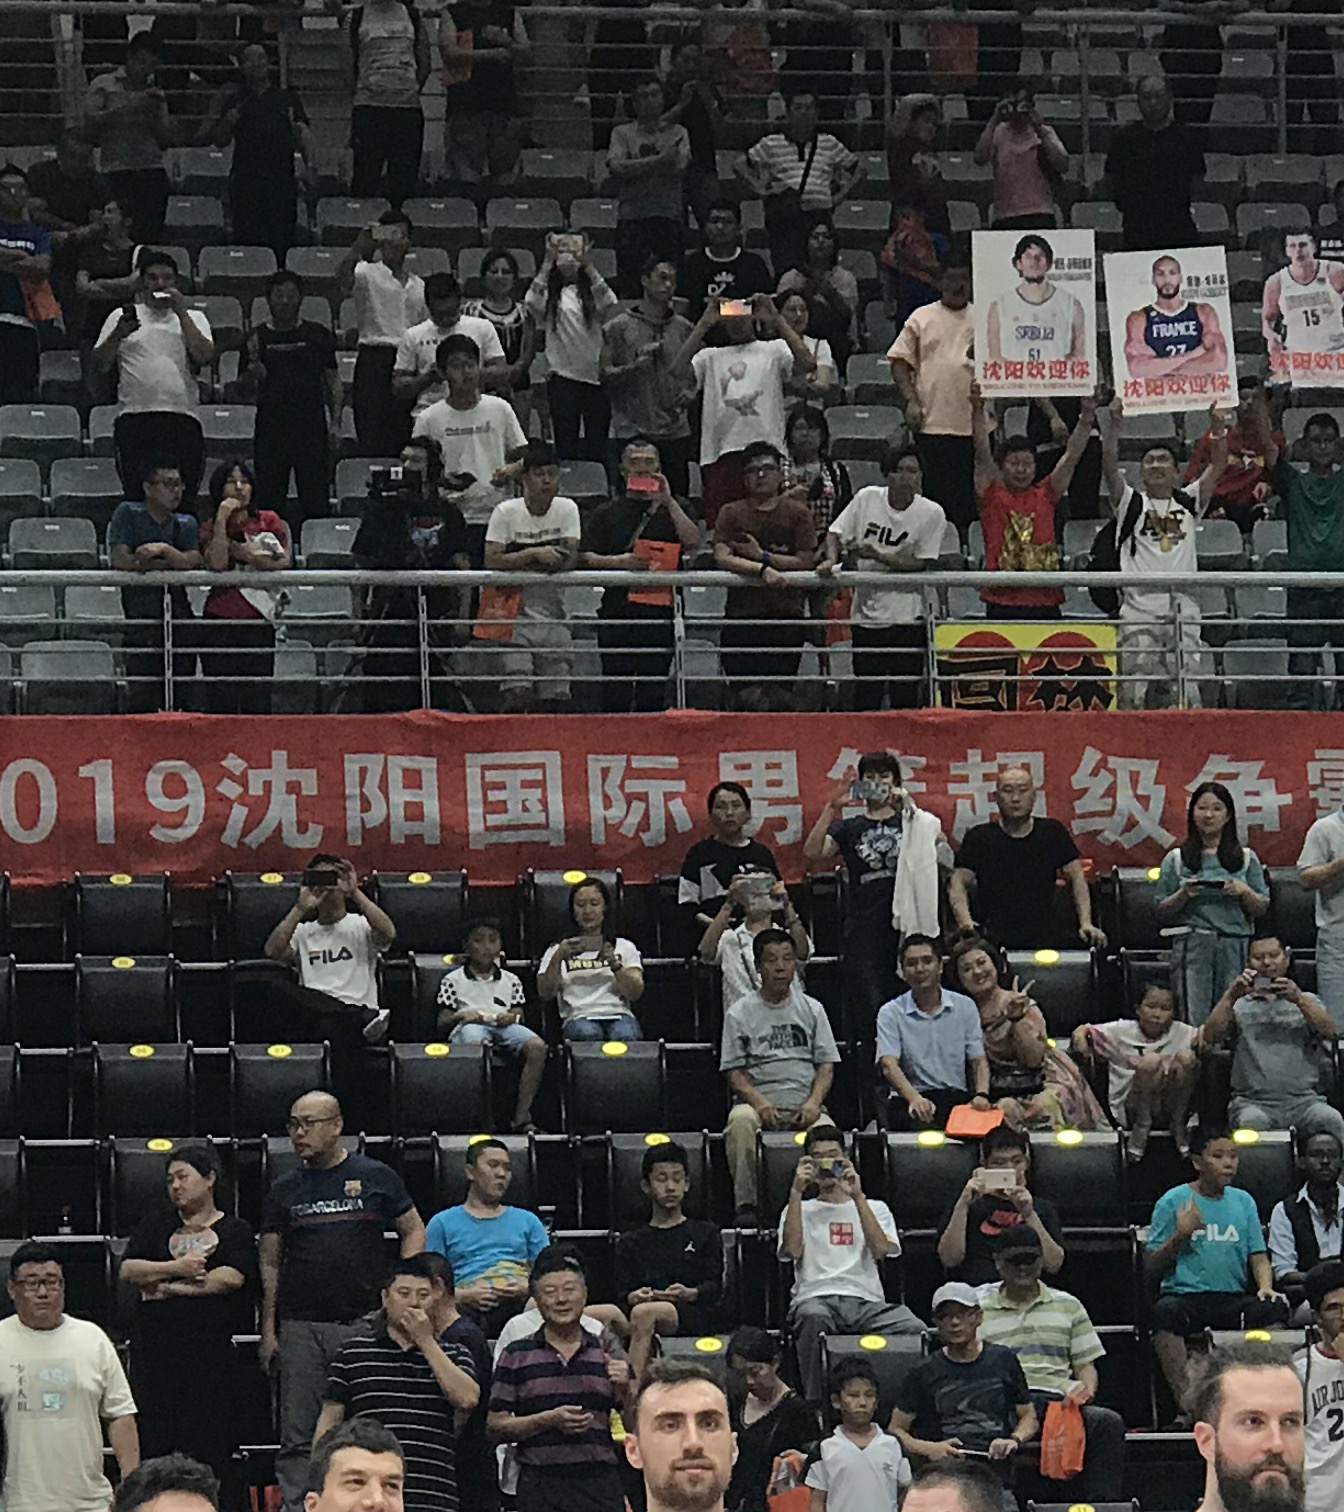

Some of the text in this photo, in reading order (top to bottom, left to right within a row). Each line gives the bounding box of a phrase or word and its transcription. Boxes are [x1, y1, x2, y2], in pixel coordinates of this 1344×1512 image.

[1302, 309, 1320, 327] 15
[1152, 320, 1198, 338] FRANCE
[982, 360, 1090, 380] 沈阳欢迎你
[1124, 373, 1231, 398] 沈阳欢迎你
[309, 947, 353, 965] FILA
[1191, 1224, 1239, 1243] FILA
[1312, 1384, 1329, 1417] AIR
